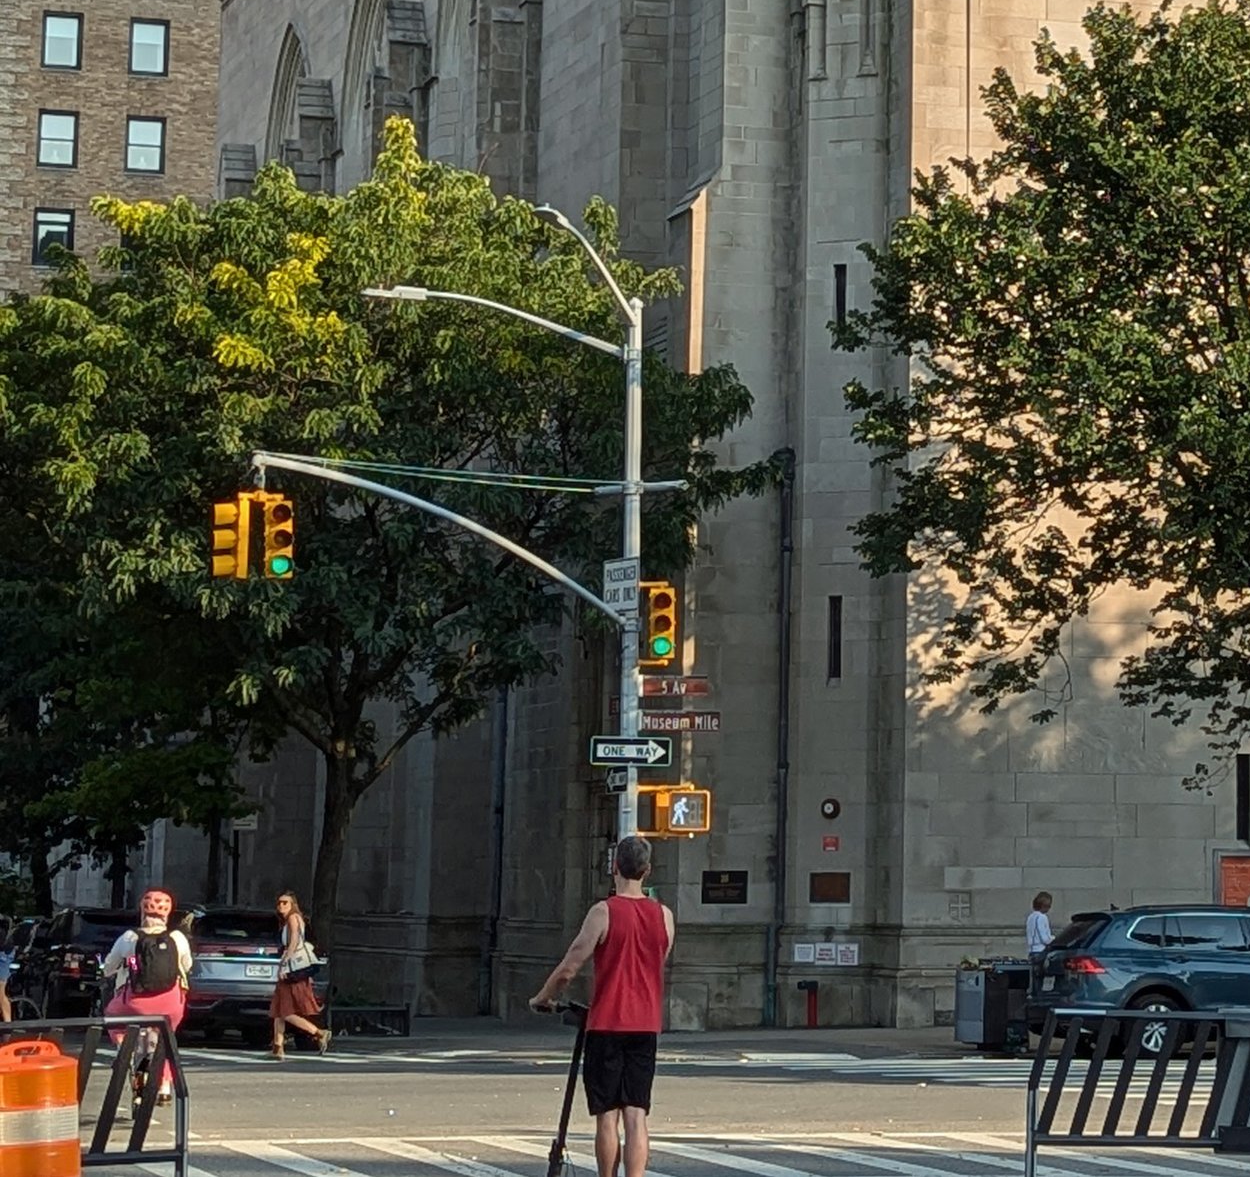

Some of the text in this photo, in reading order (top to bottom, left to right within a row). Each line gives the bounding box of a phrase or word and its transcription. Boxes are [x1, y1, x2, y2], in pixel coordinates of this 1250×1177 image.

[661, 681, 688, 694] 5 Av
[643, 715, 719, 731] Museum Mile
[602, 745, 659, 756] ONE WAY
